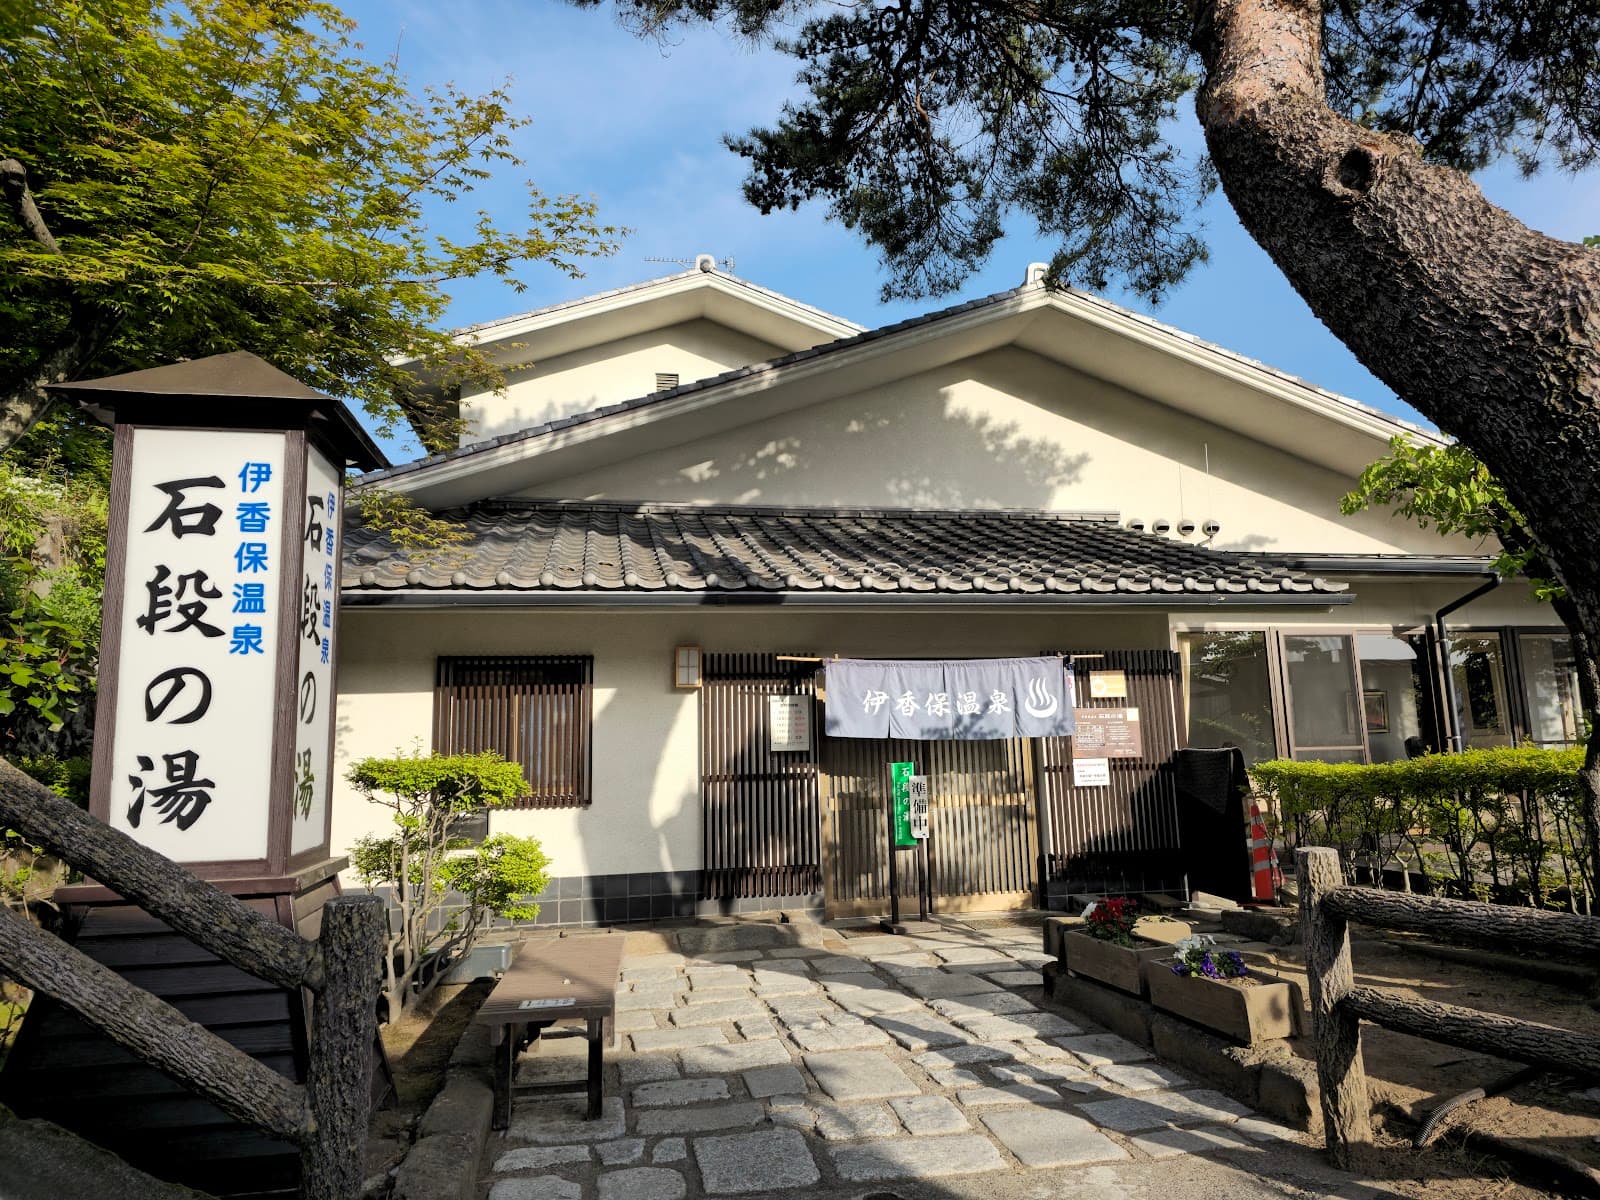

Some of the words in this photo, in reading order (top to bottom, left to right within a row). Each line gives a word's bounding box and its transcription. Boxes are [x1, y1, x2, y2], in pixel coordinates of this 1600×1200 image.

[230, 461, 273, 655] 伊香保温泉
[319, 492, 336, 664] 伊香保温泉
[127, 475, 226, 832] 石段の湯
[294, 495, 324, 822] 石段の湯
[863, 688, 1011, 717] 伊香保温泉
[911, 782, 928, 831] 準備中
